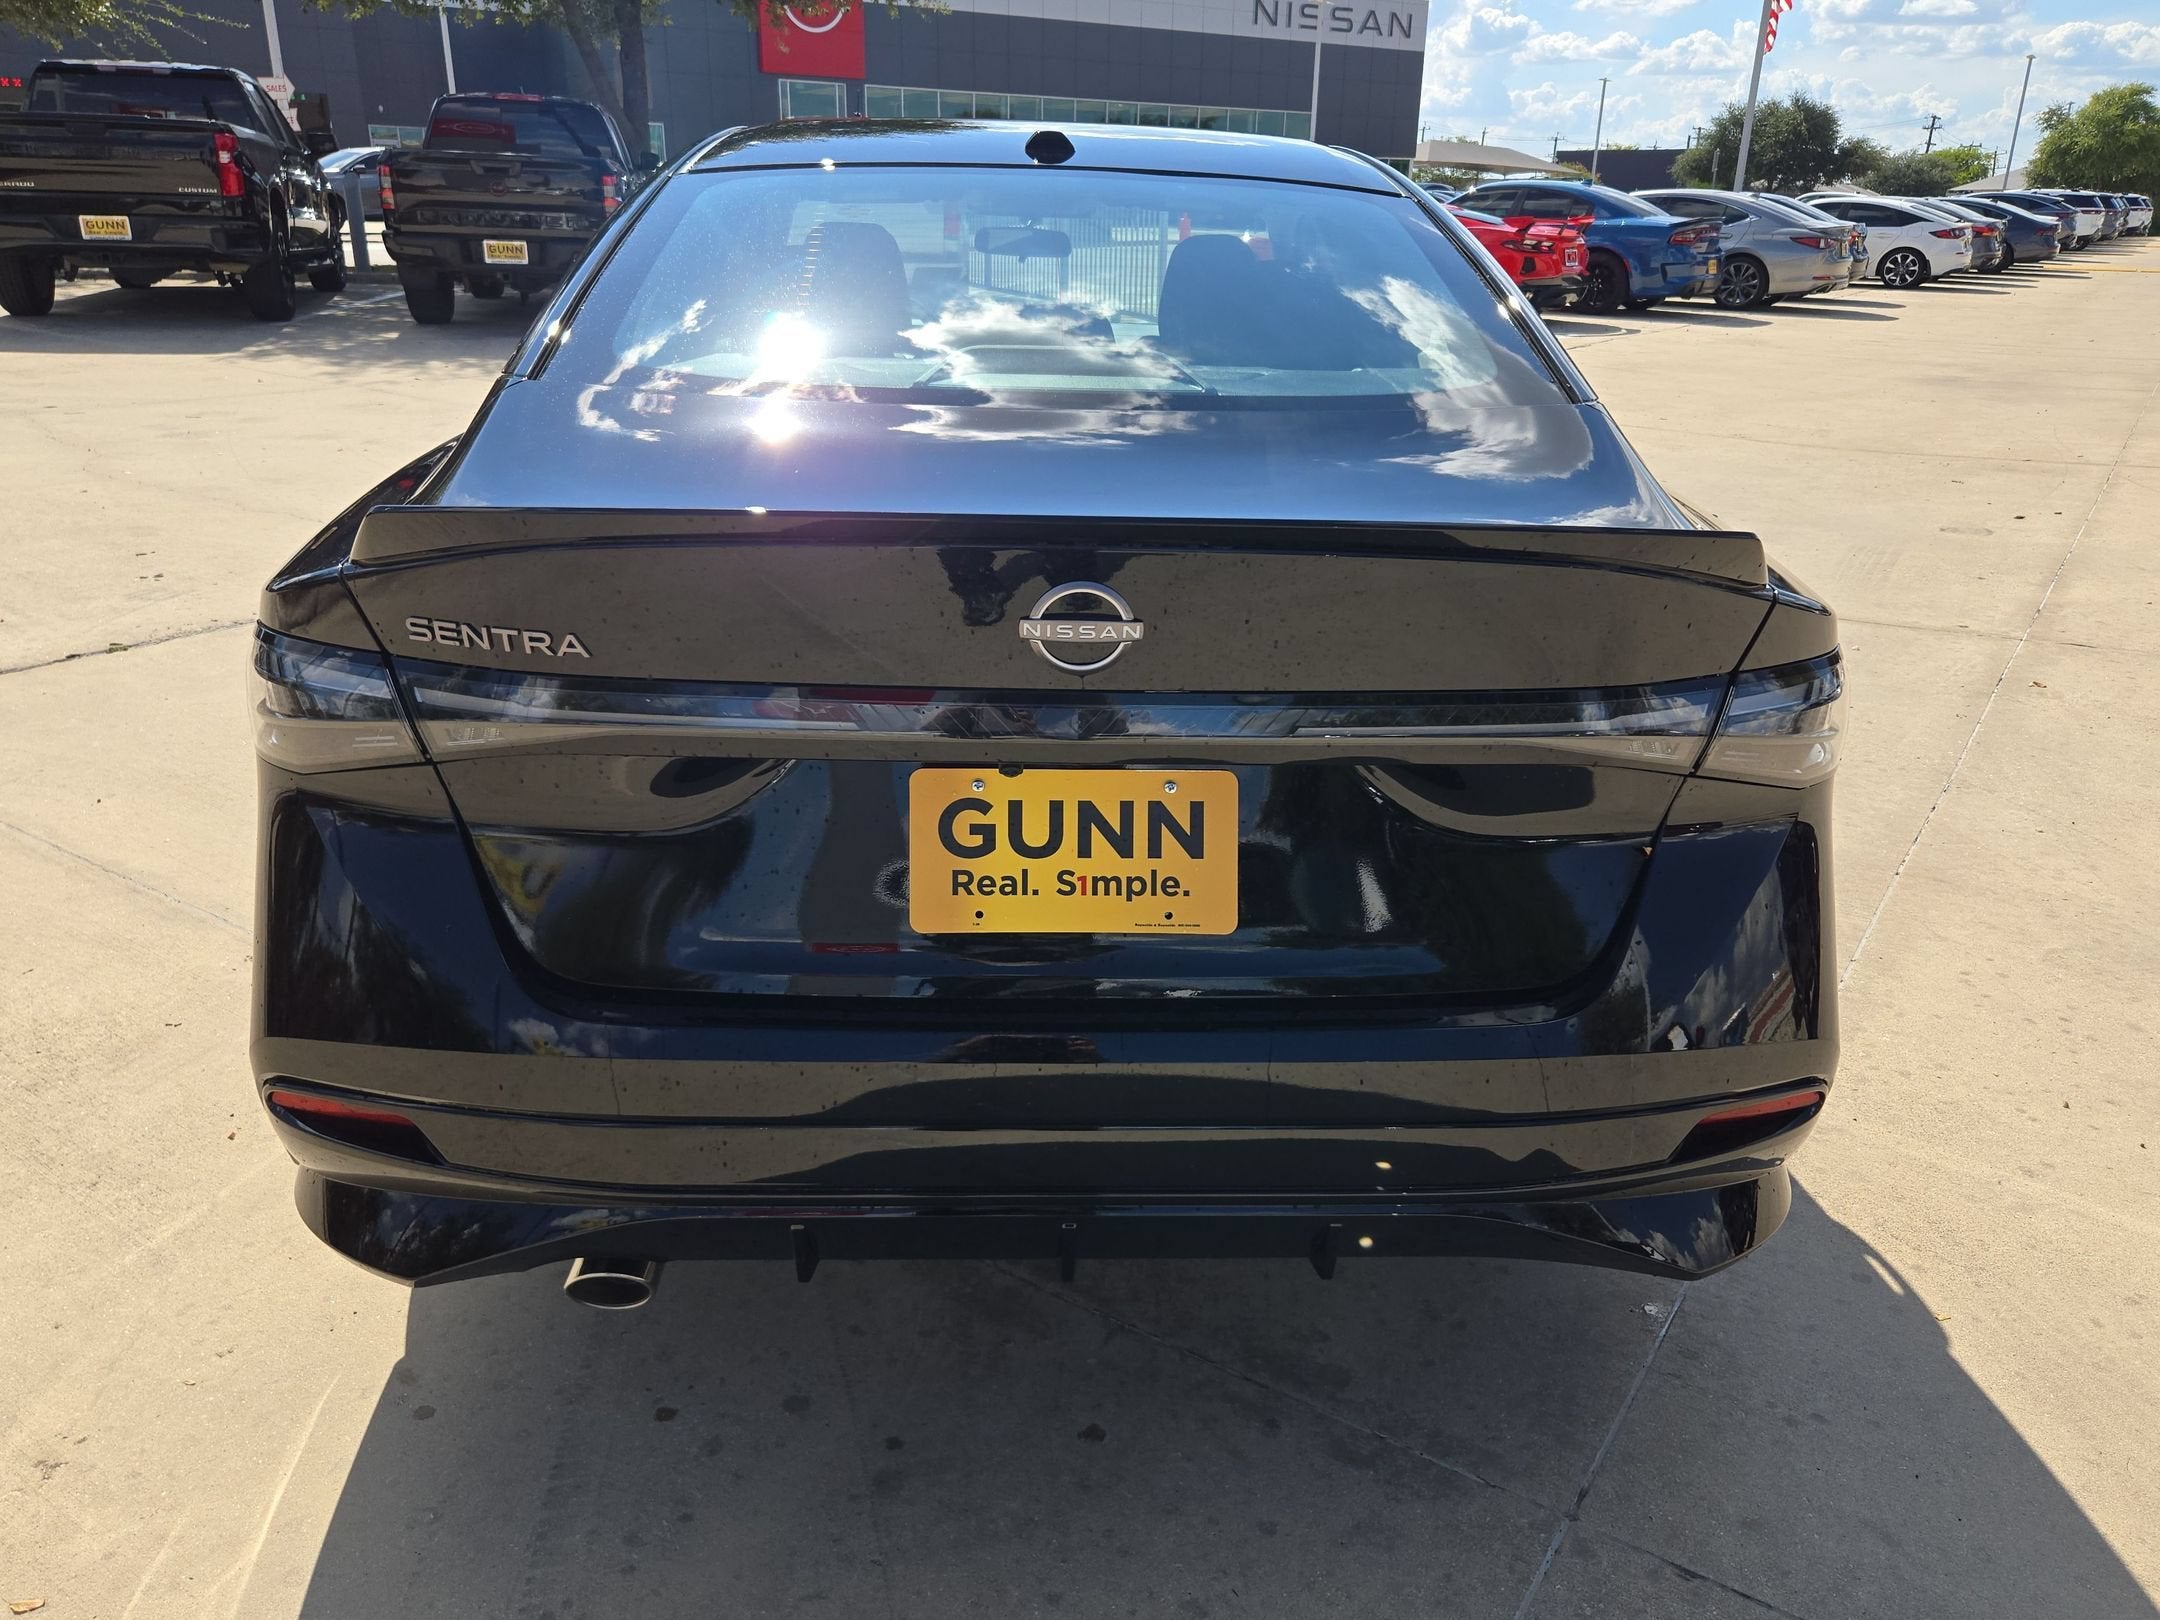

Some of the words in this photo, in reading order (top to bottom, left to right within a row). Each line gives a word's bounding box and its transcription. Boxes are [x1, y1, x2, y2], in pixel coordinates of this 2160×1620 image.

[1252, 0, 1413, 39] NISSAN
[266, 84, 287, 92] SALES
[85, 220, 126, 230] GUNN
[488, 244, 523, 254] GUNN
[405, 615, 592, 658] SENTRA
[1023, 622, 1141, 639] NISSAN
[937, 796, 1205, 860] GUNN
[951, 868, 1040, 897] Real.
[1056, 869, 1191, 902] S1mple.
